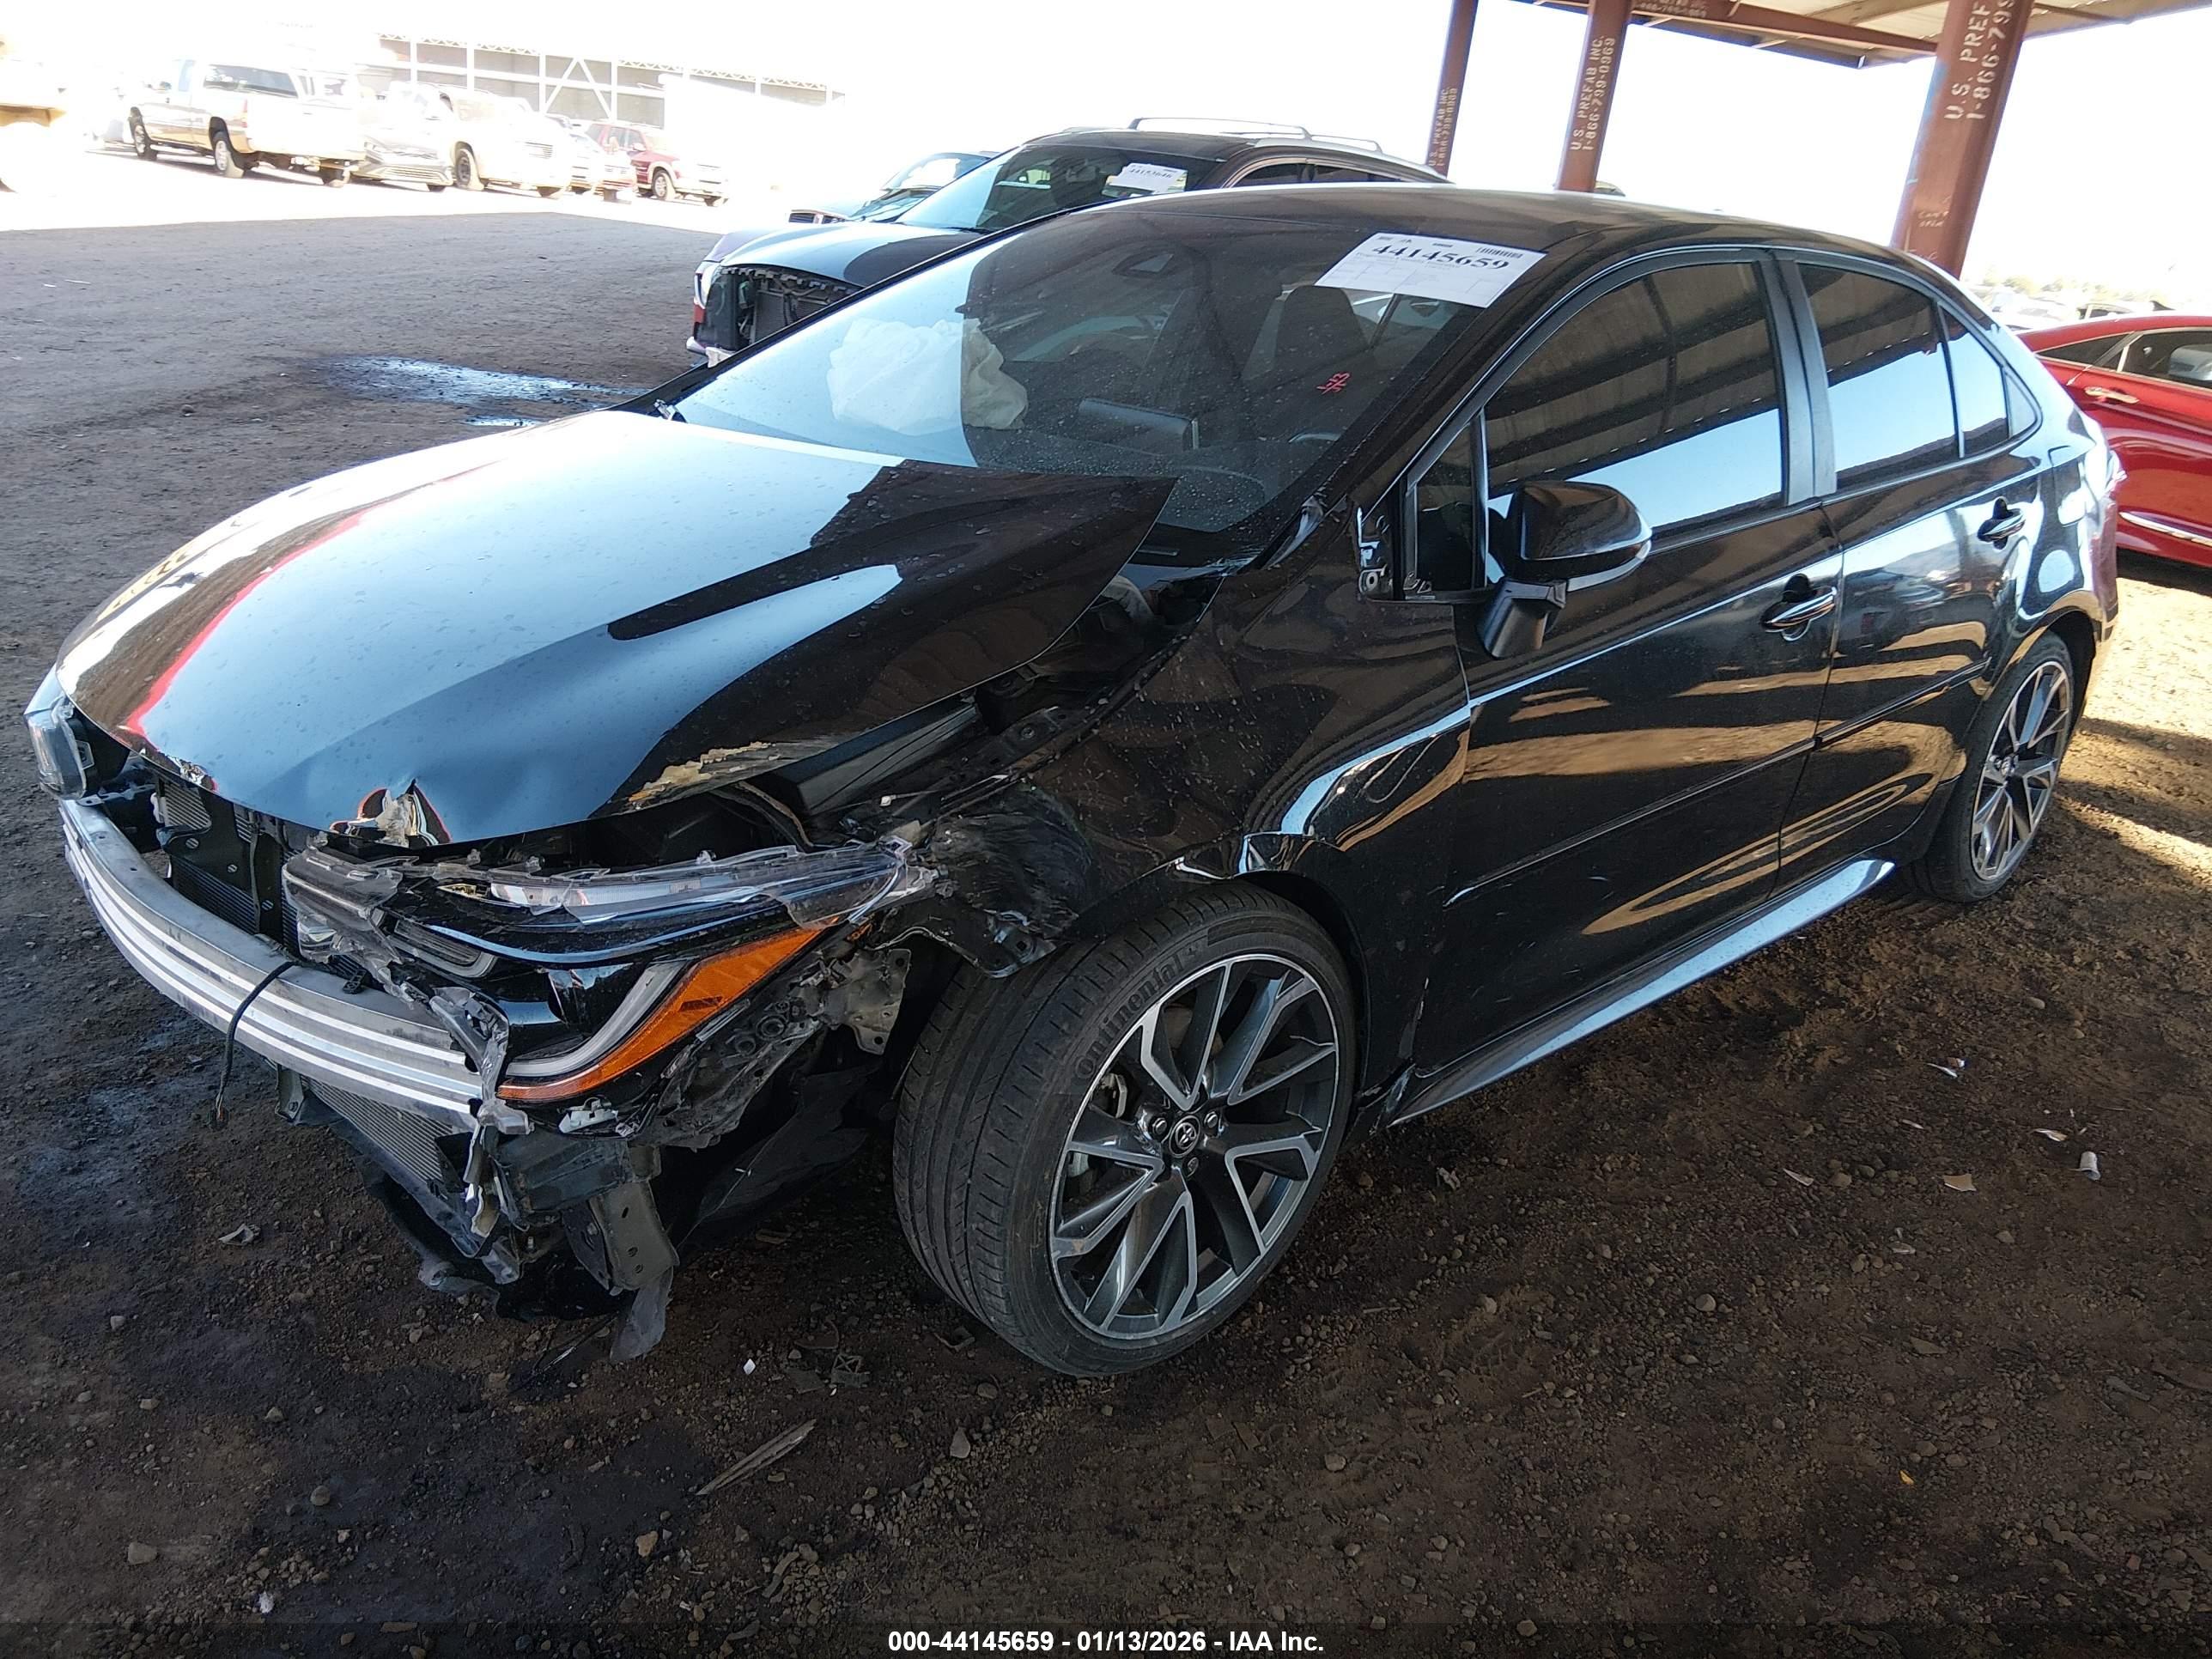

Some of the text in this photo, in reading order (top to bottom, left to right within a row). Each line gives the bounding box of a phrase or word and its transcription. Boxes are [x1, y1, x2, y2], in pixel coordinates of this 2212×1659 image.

[1571, 35, 1604, 150] U.S. PREFAB INC.
[1582, 37, 1615, 151] 1-866-799-0969
[1943, 76, 1973, 119] U.S.
[1372, 244, 1510, 270] 44145659
[1074, 951, 1184, 1079] Continental
